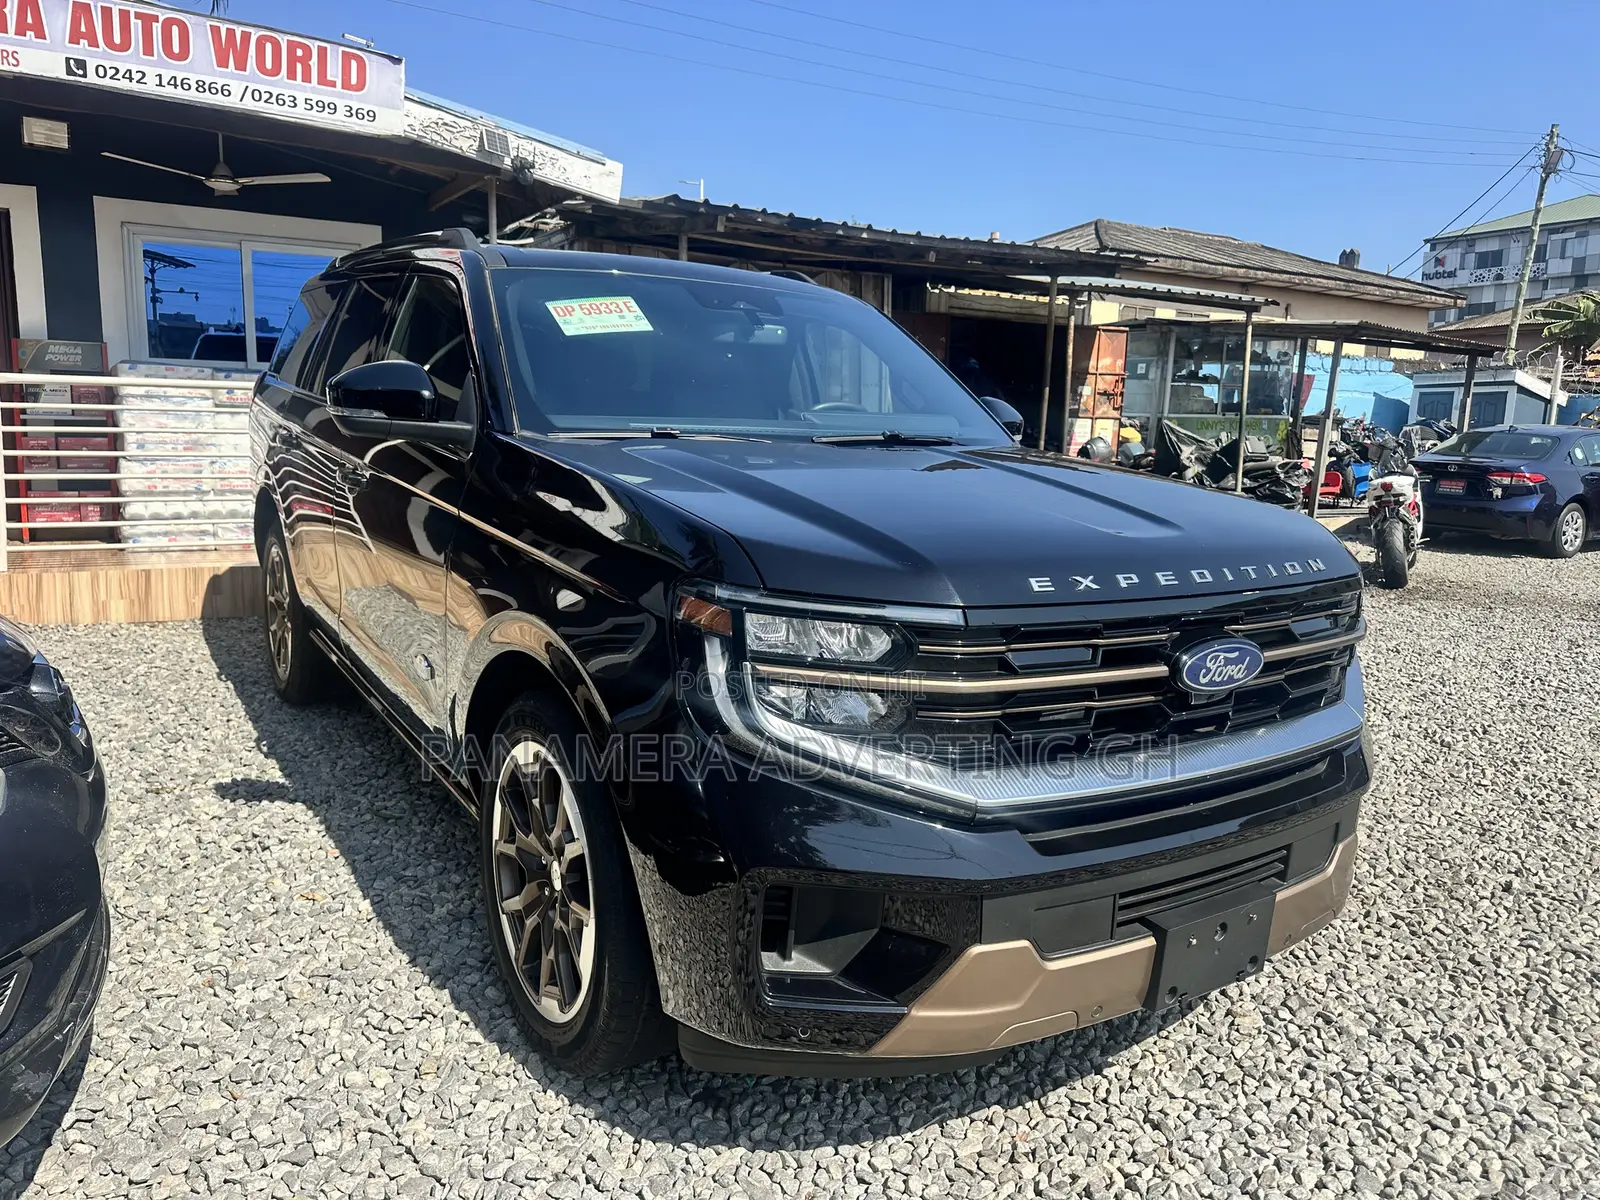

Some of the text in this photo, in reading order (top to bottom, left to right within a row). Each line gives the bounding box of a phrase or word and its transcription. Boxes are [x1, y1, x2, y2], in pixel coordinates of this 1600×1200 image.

[67, 1, 191, 62] AUTO
[208, 24, 368, 93] WORLD
[1, 49, 20, 67] RS
[95, 64, 147, 85] 0242
[303, 98, 338, 115] 599
[343, 105, 377, 122] 369
[1421, 268, 1458, 281] hubtel
[552, 301, 637, 318] DP 5933 E
[45, 353, 82, 362] POWER
[47, 345, 82, 354] MEGA
[1229, 418, 1262, 431] KITHEN
[1028, 558, 1327, 593] EXPEDITION
[1199, 650, 1250, 684] Ford
